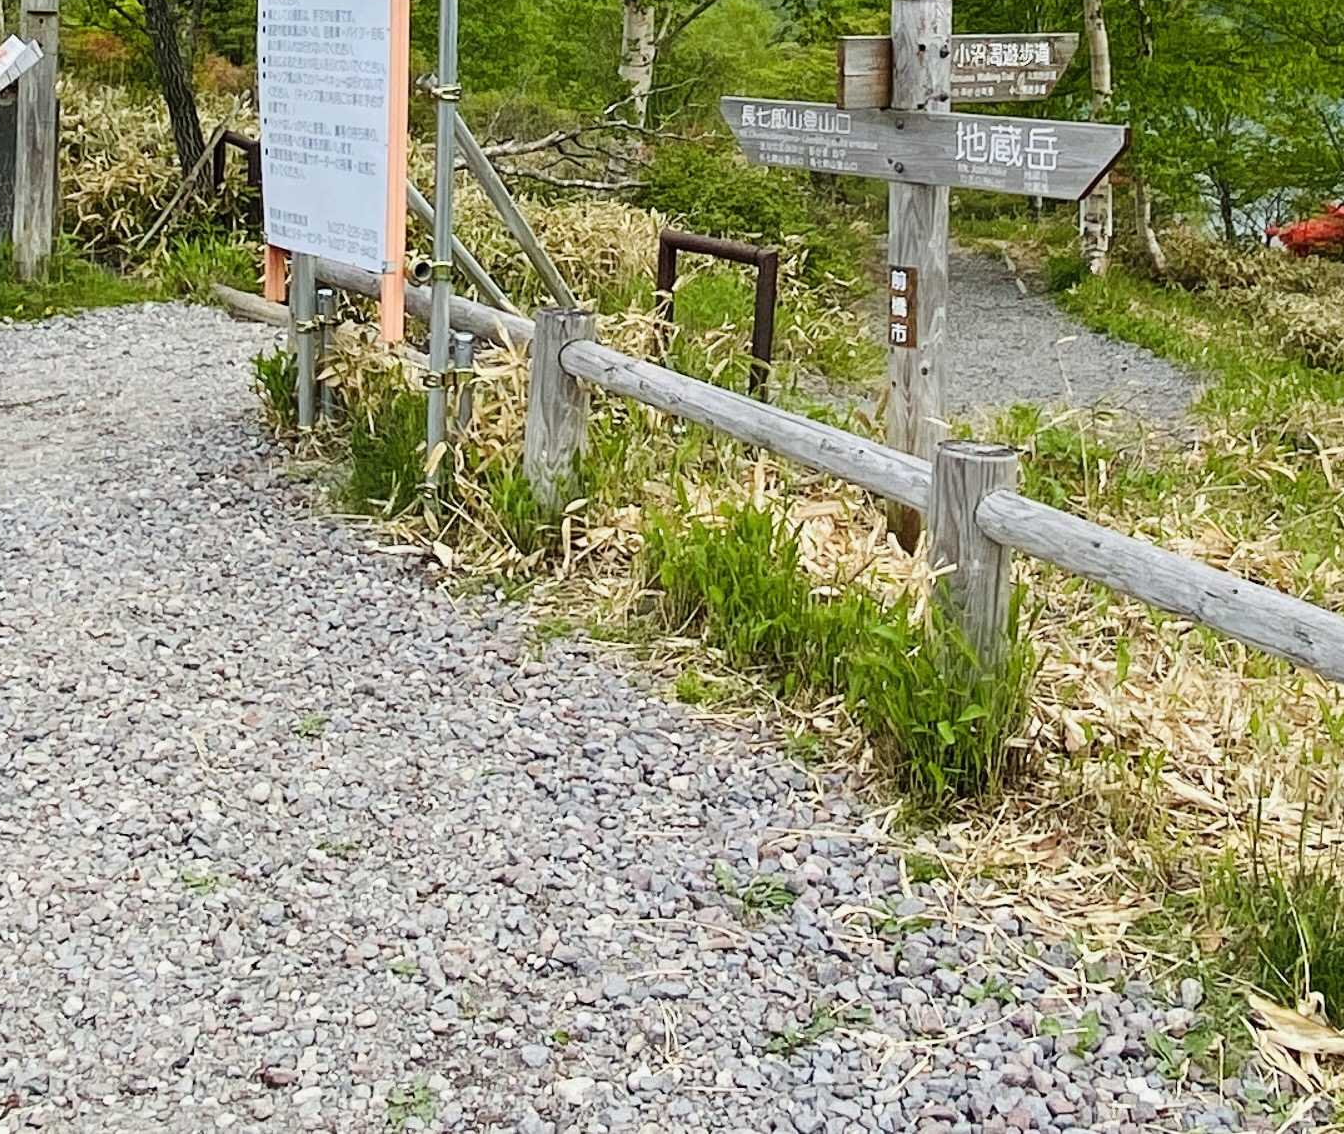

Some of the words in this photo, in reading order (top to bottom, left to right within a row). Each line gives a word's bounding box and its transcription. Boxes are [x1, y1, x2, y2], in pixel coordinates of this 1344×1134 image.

[953, 41, 1050, 68] 小沼周遊歩道
[741, 105, 852, 135] 長七郎山登山口
[955, 121, 1060, 171] 地蔵岳
